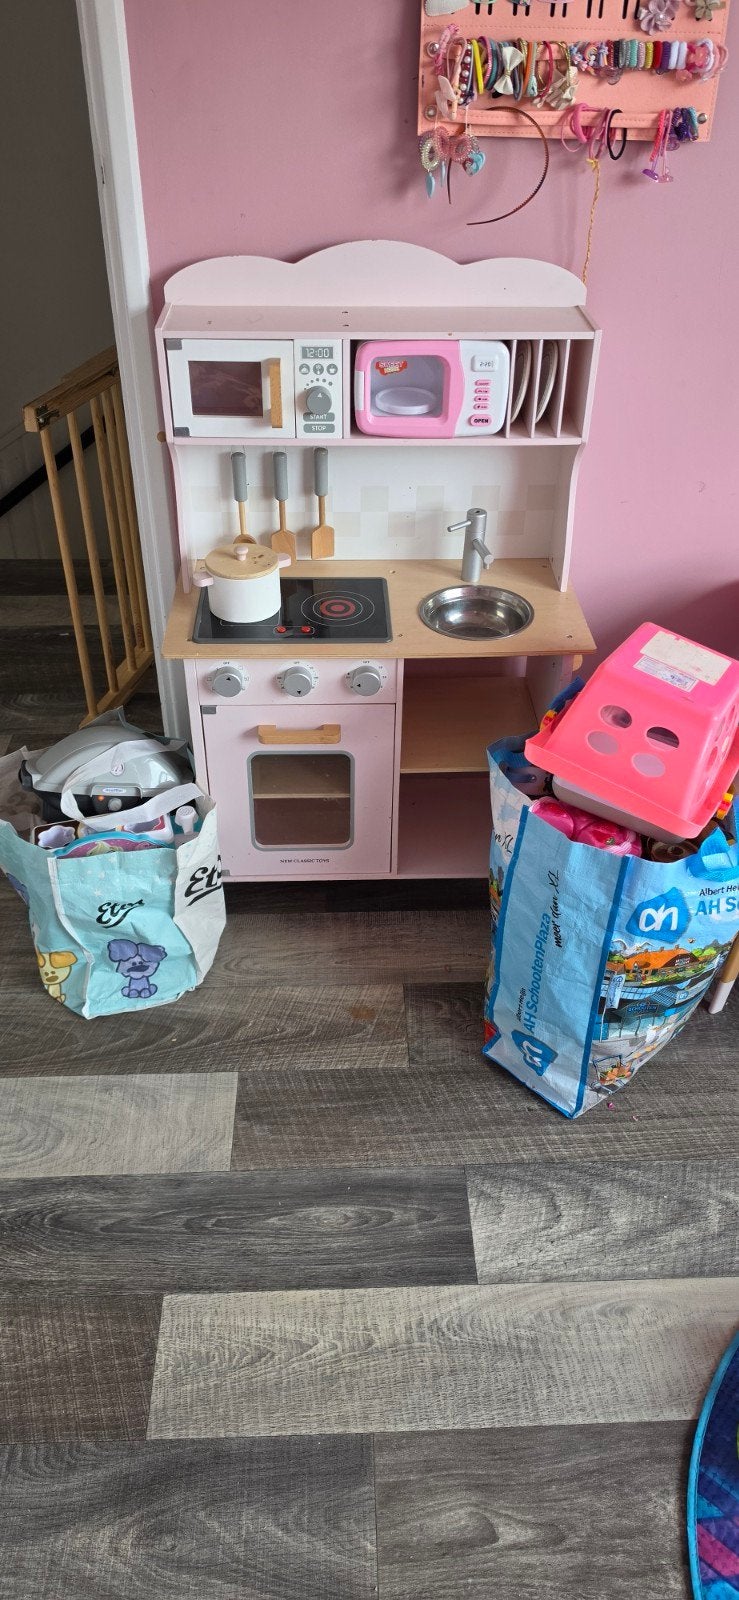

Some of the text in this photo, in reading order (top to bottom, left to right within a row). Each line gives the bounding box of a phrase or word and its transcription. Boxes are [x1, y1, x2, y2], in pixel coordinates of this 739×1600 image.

[305, 348, 329, 358] 12:00
[547, 869, 560, 895] XL
[699, 886, 725, 896] Albert
[695, 899, 721, 916] AH
[551, 920, 563, 949] meer
